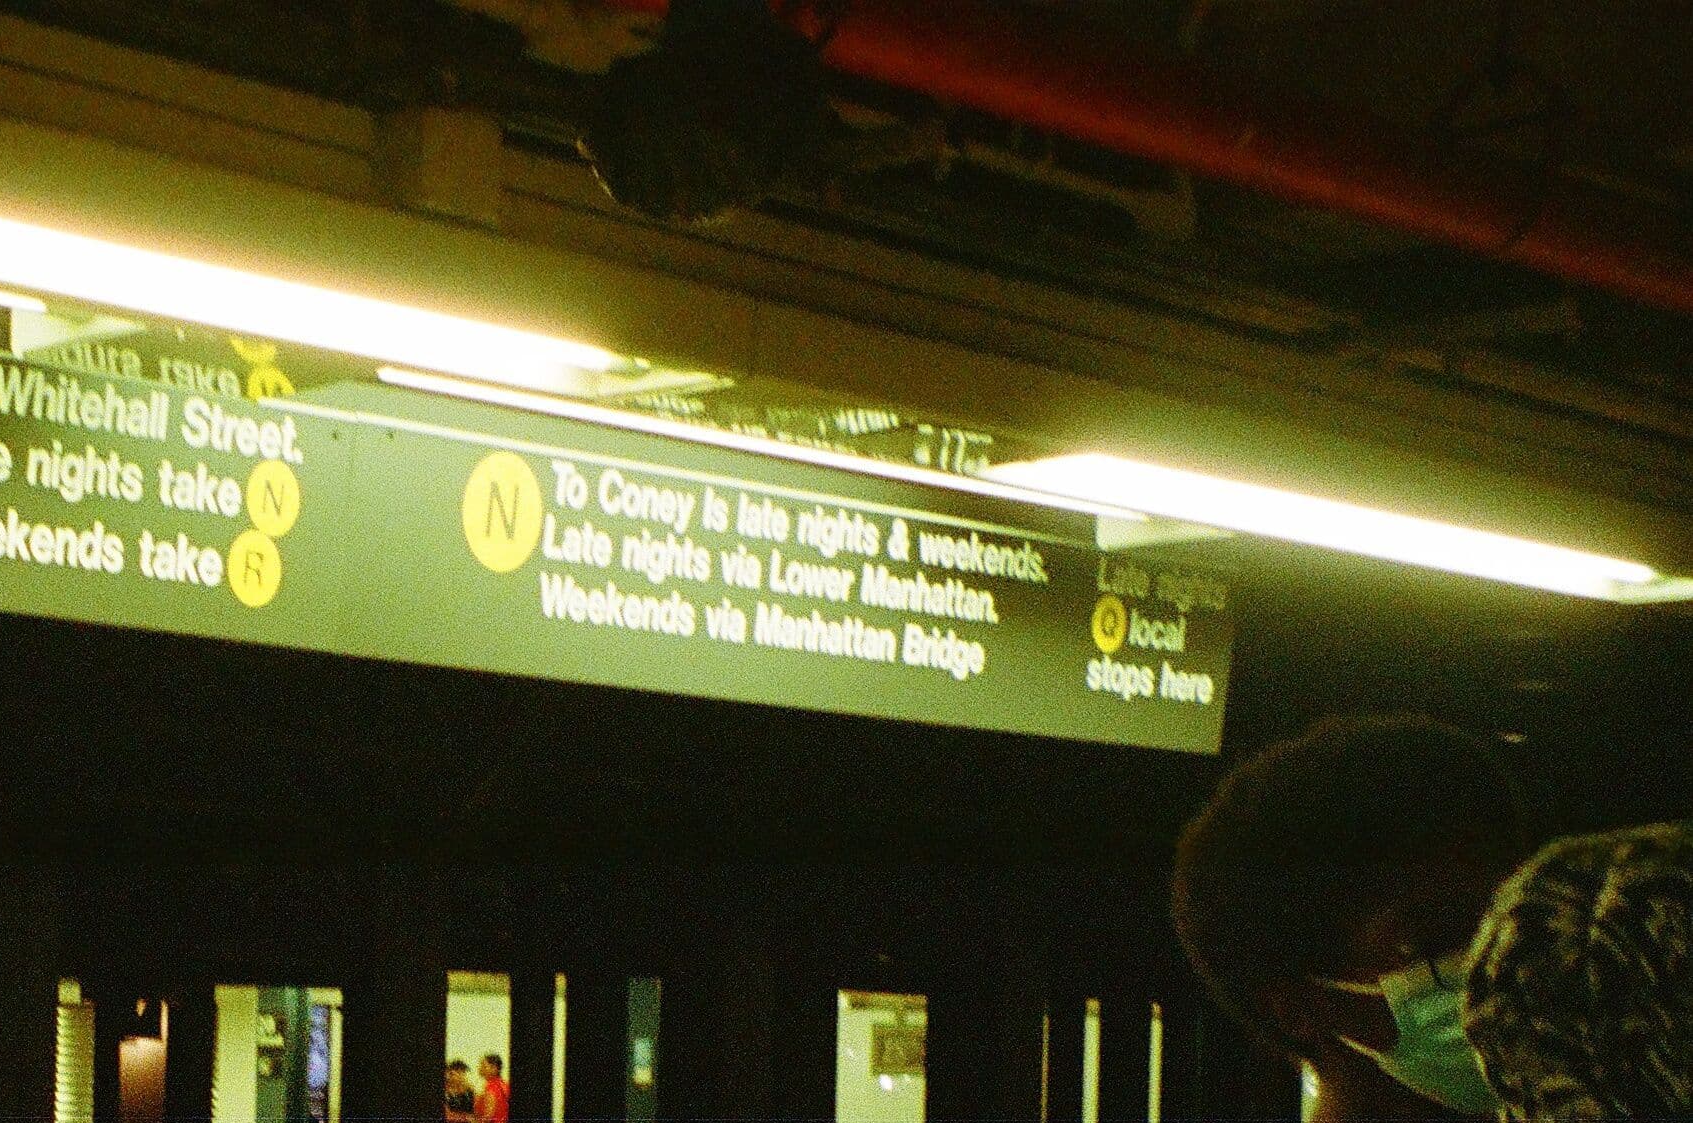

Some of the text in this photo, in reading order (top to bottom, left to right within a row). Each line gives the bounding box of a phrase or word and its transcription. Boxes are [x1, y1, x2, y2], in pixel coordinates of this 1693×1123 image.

[181, 403, 303, 465] Street.
[26, 441, 142, 503] nights
[159, 458, 242, 517] take
[552, 458, 1050, 587] To Coney Is late nights & weekends.
[139, 530, 224, 588] take
[544, 515, 999, 626] Late nights via Lower Manhattan.
[540, 572, 985, 682] Weekends via Manhattan Bridge
[1129, 608, 1186, 653] local
[1086, 653, 1214, 705] stops here
